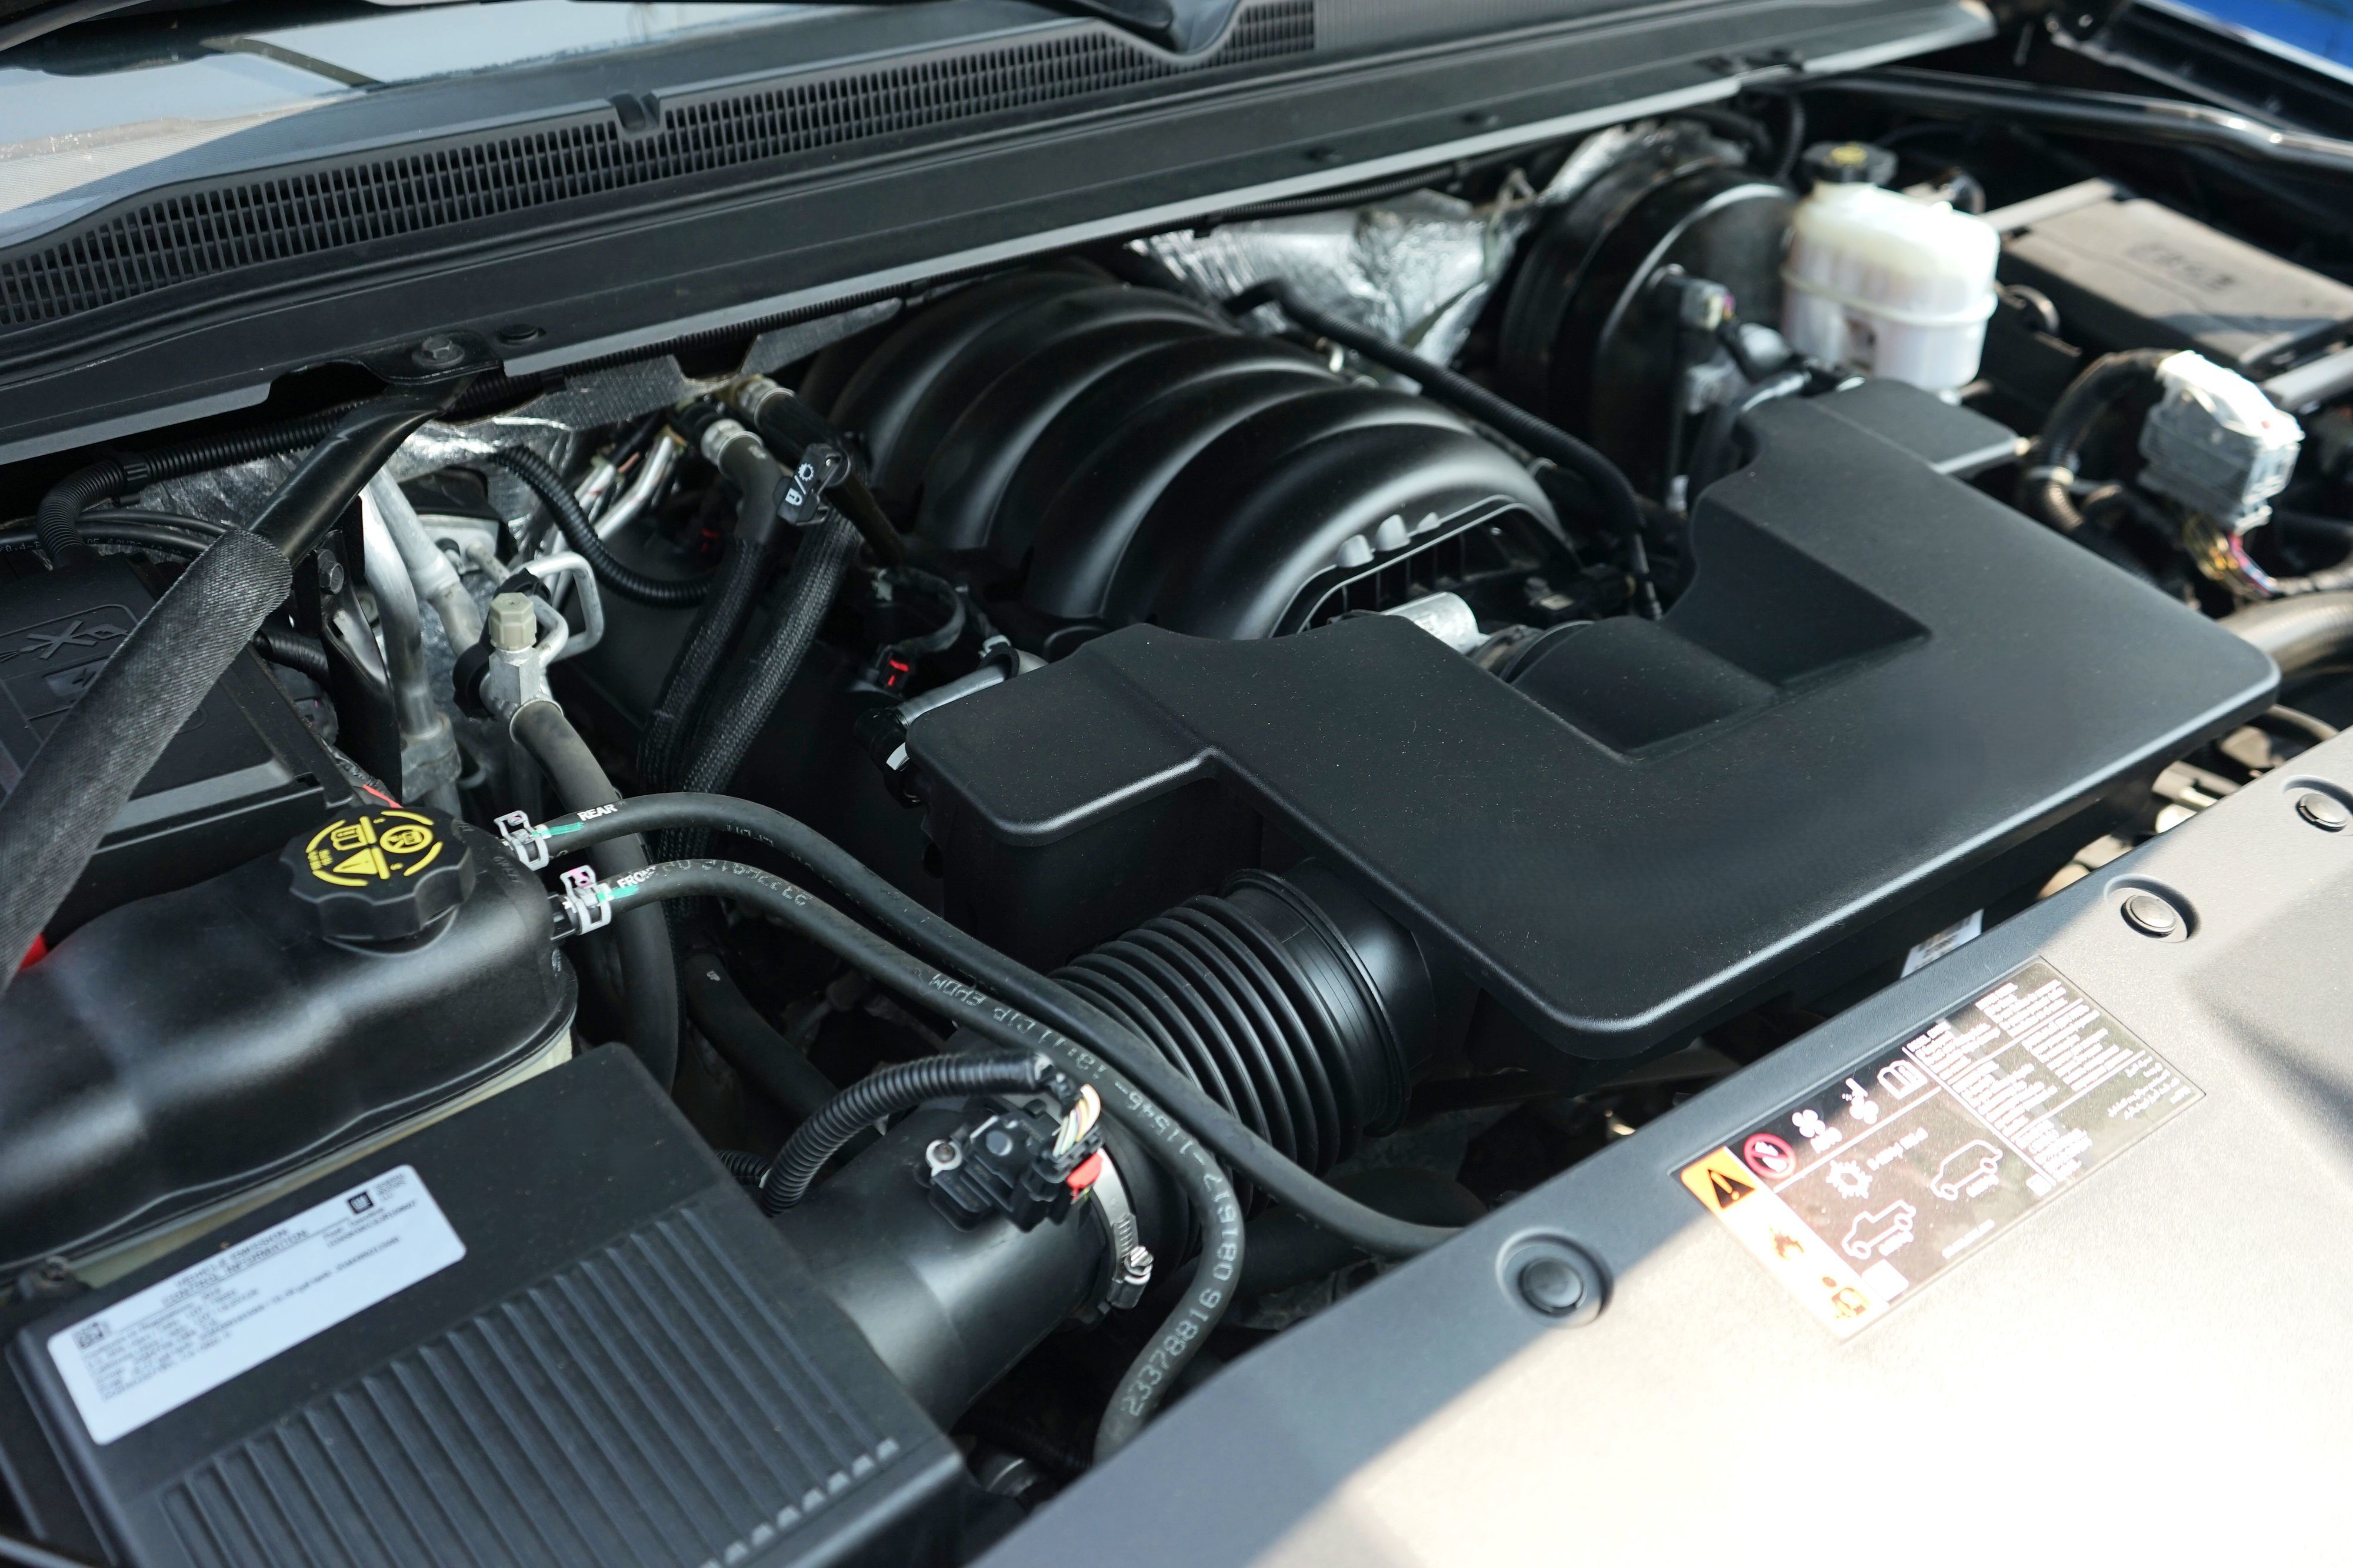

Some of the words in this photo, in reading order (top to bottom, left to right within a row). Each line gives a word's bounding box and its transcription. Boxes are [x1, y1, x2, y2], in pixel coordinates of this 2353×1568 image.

[577, 803, 618, 821] REAR
[616, 865, 656, 889] FRONT
[928, 973, 988, 1007] EPDM
[1120, 1287, 1223, 1417] 23378816
